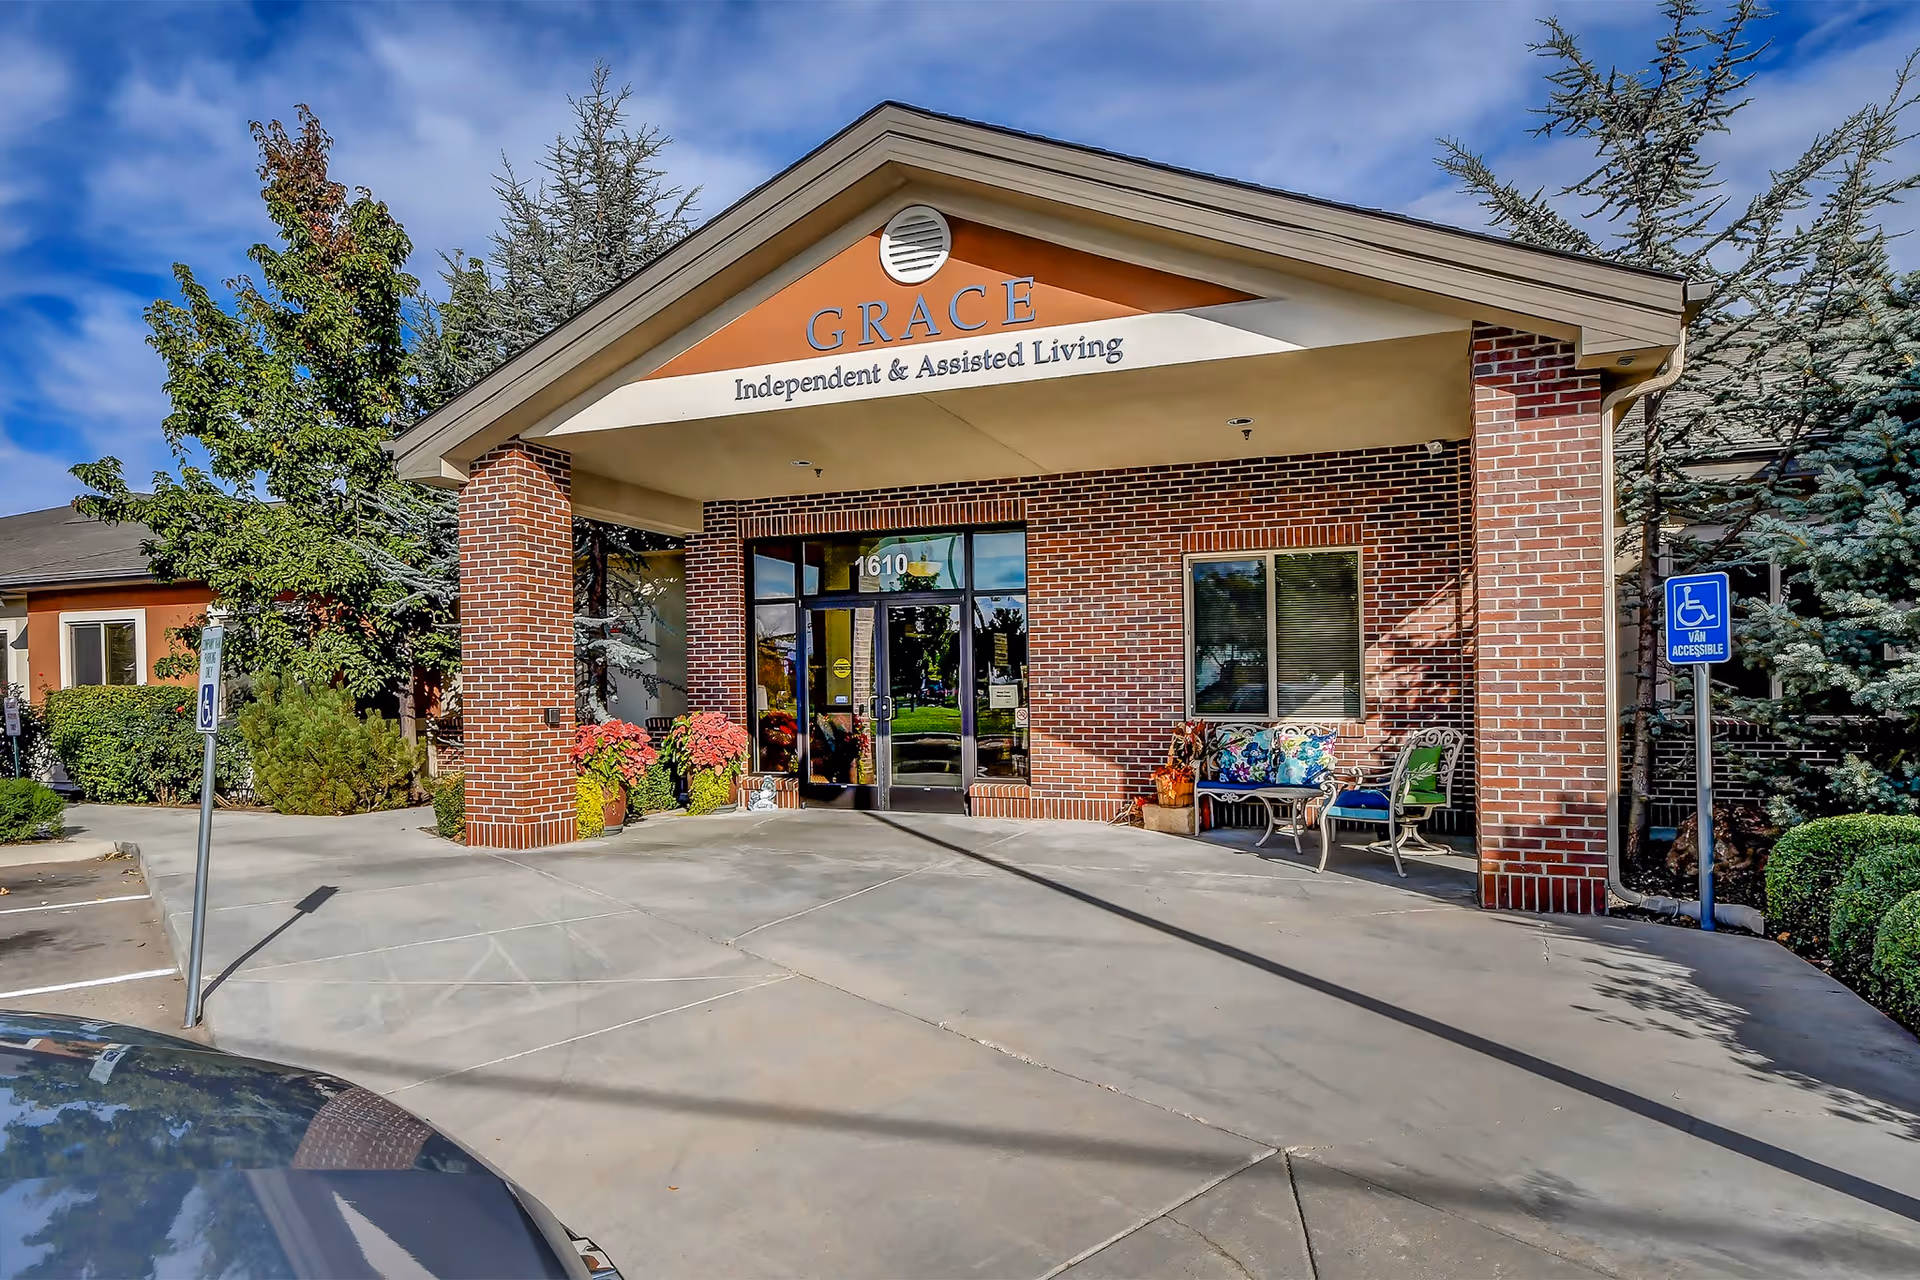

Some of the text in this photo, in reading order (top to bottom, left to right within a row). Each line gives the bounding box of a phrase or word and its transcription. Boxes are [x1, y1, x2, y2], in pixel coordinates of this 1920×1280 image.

[806, 276, 1036, 351] GRACE
[734, 335, 1124, 402] Independent & Assisted Living
[854, 553, 908, 577] 1610
[1688, 630, 1706, 643] VAN
[1672, 643, 1724, 657] ACCESSIBLE
